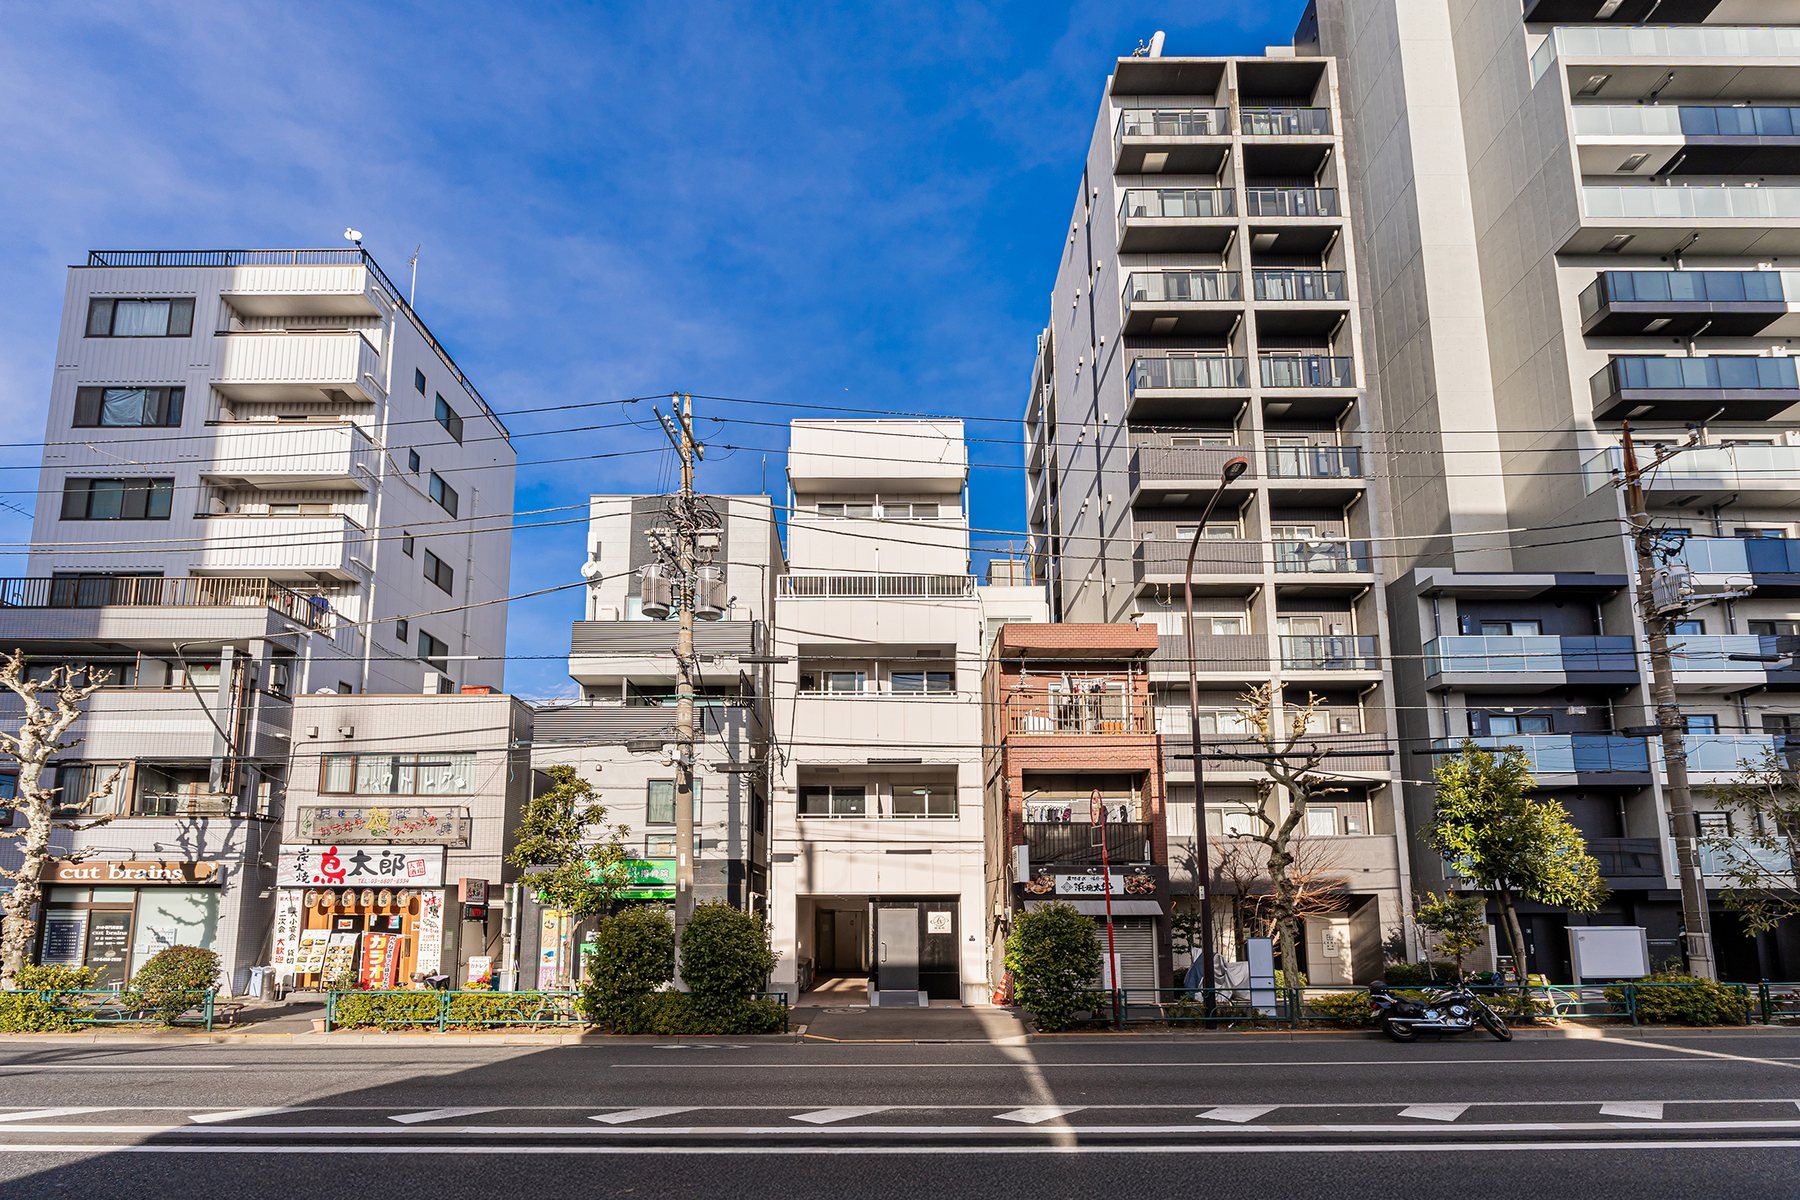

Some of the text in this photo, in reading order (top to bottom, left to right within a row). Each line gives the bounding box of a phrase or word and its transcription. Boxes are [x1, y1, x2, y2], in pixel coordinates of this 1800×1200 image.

[60, 863, 184, 880] cut brains
[293, 847, 310, 883] 炭火焼
[275, 910, 287, 964] 二次会 大歓迎
